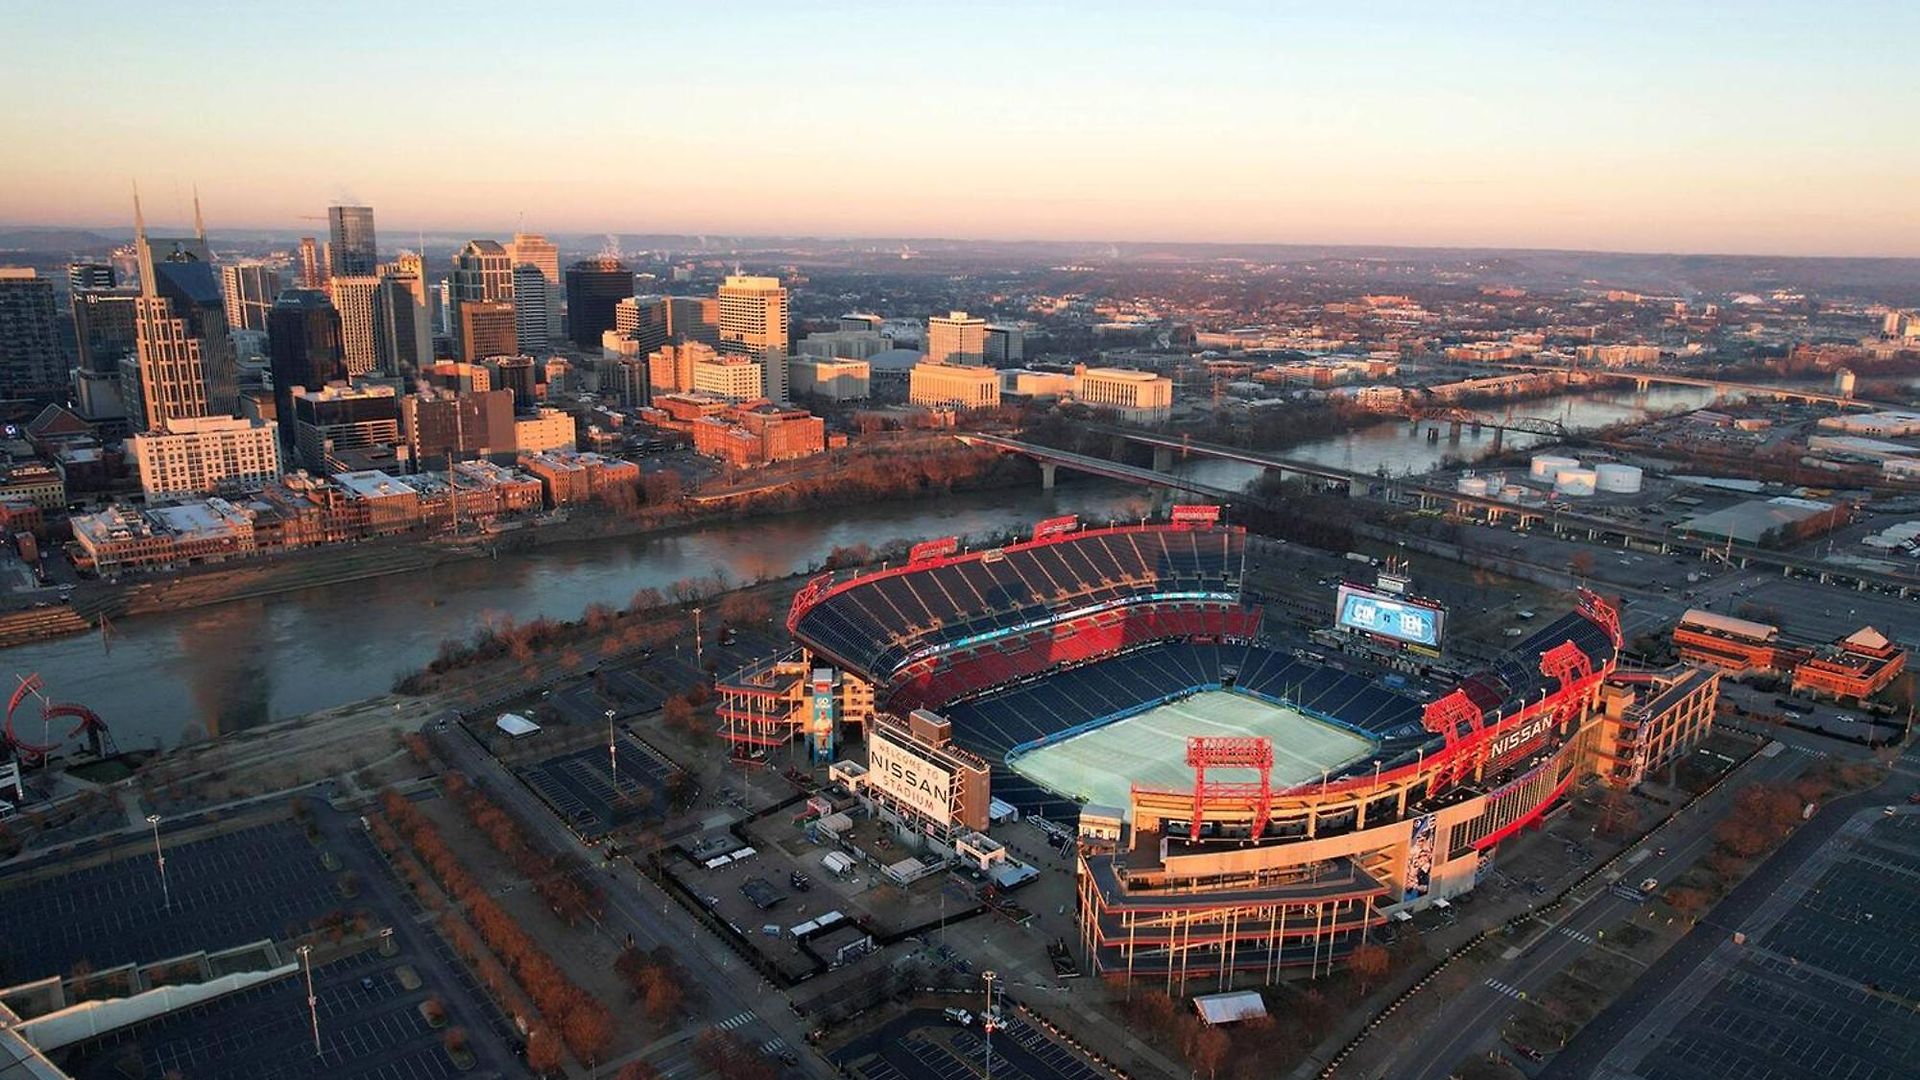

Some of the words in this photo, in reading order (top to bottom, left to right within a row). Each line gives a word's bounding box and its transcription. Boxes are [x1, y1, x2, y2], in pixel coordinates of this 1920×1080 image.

[1491, 714, 1553, 758] NISSAN
[871, 751, 947, 804] NISSAN
[879, 742, 922, 772] WELCOME
[927, 768, 939, 781] TO
[883, 775, 934, 811] STADIUM
